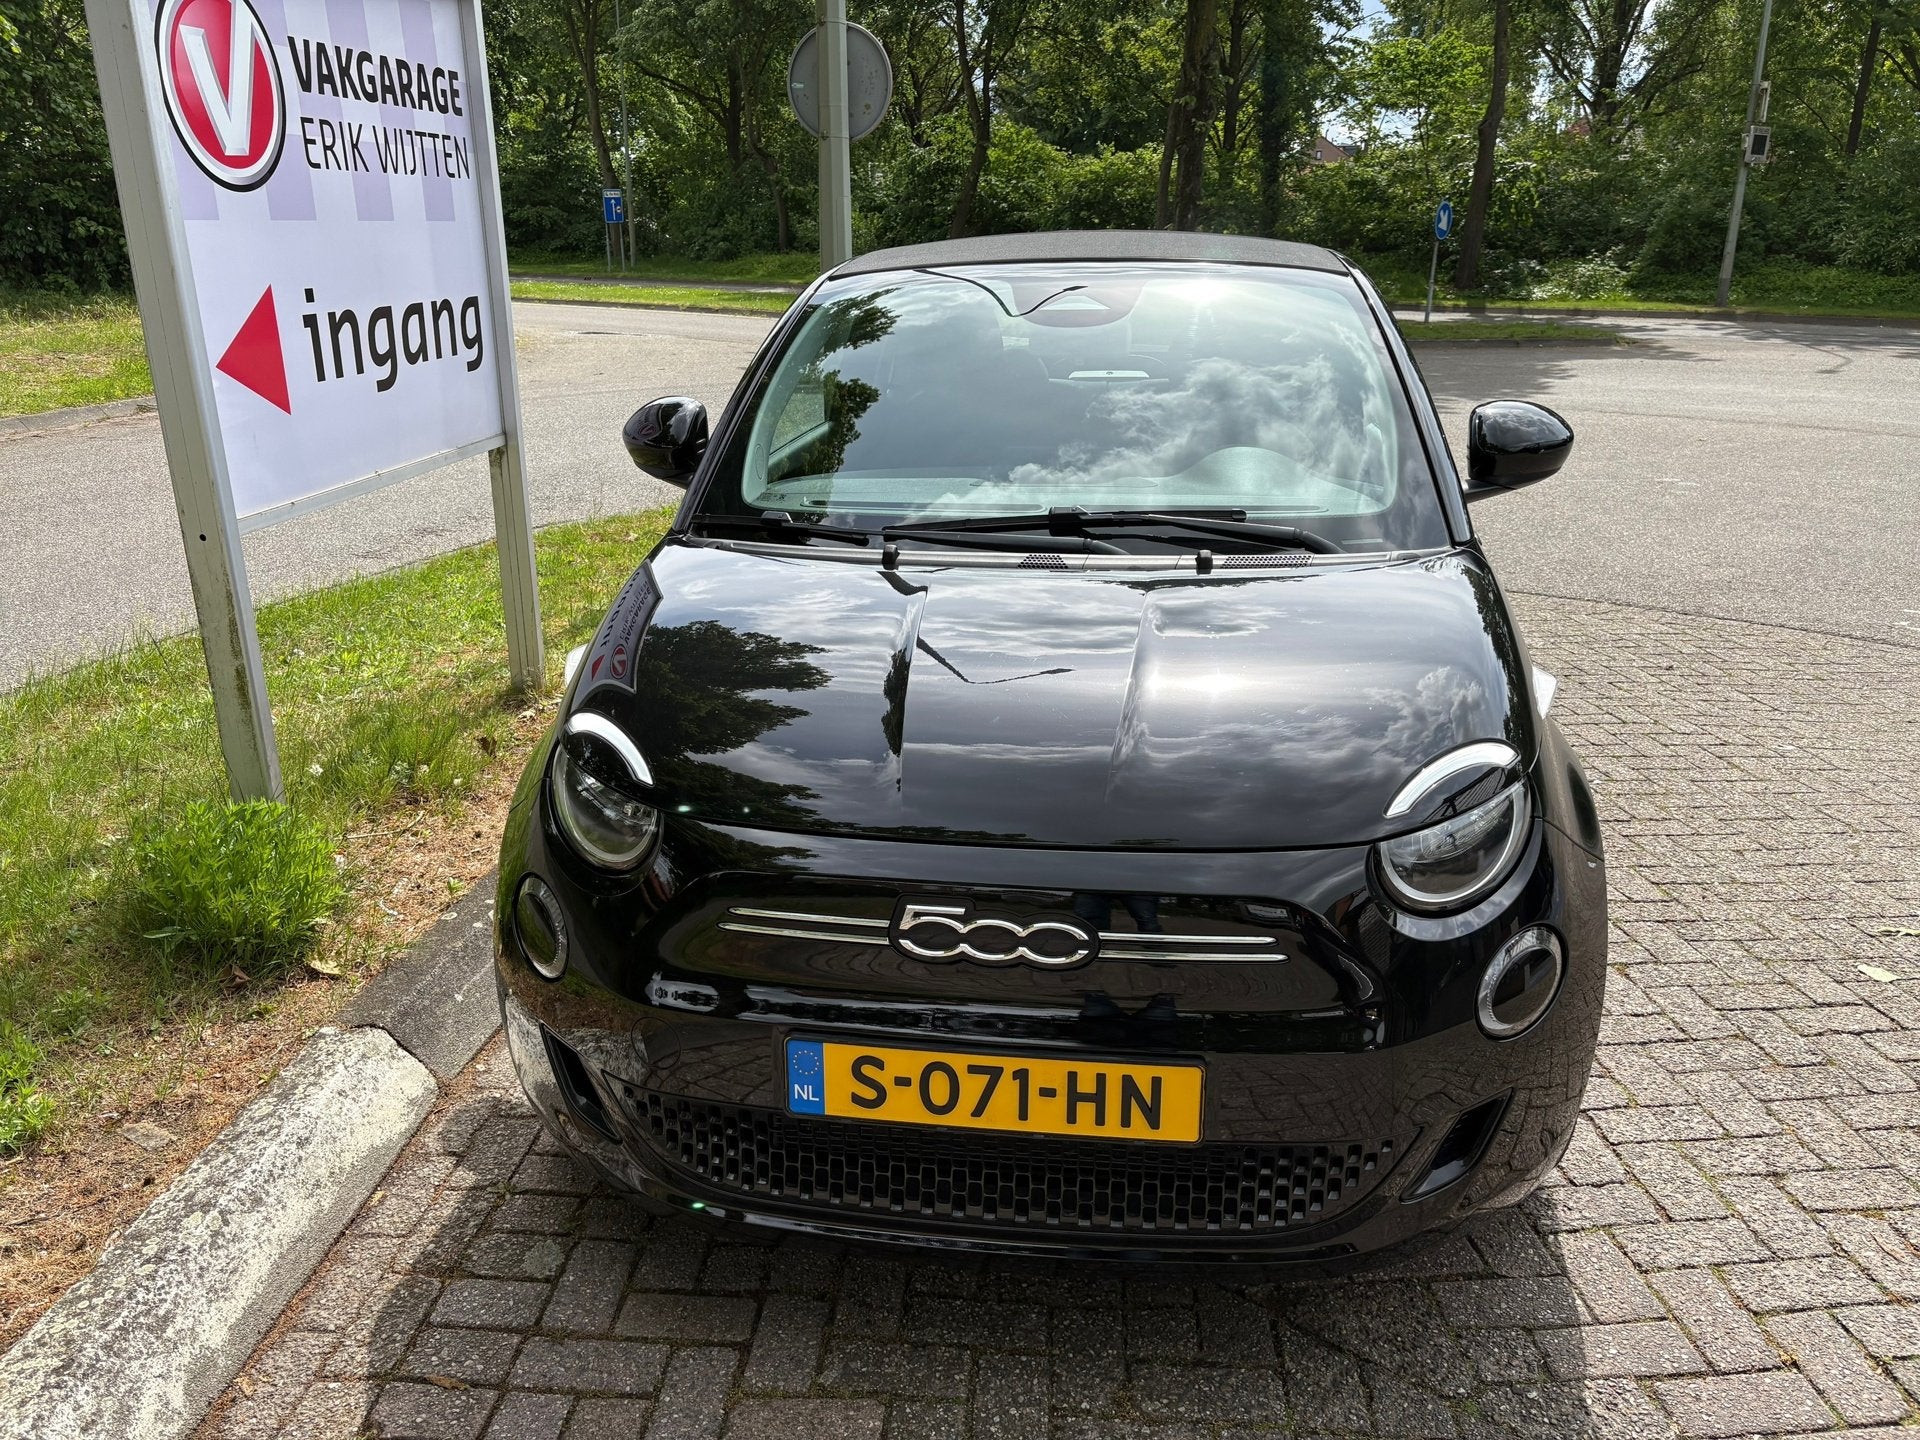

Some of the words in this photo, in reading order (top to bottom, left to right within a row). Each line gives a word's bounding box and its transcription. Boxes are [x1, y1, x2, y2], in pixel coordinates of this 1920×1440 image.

[179, 0, 254, 156] V
[287, 35, 463, 117] VAKGARAGE
[299, 116, 370, 173] ERIK
[372, 125, 471, 180] WIJTTEN
[302, 287, 484, 393] ingang
[899, 904, 1090, 964] 500
[793, 1083, 820, 1102] NL
[850, 1054, 1163, 1131] S-071-HN
